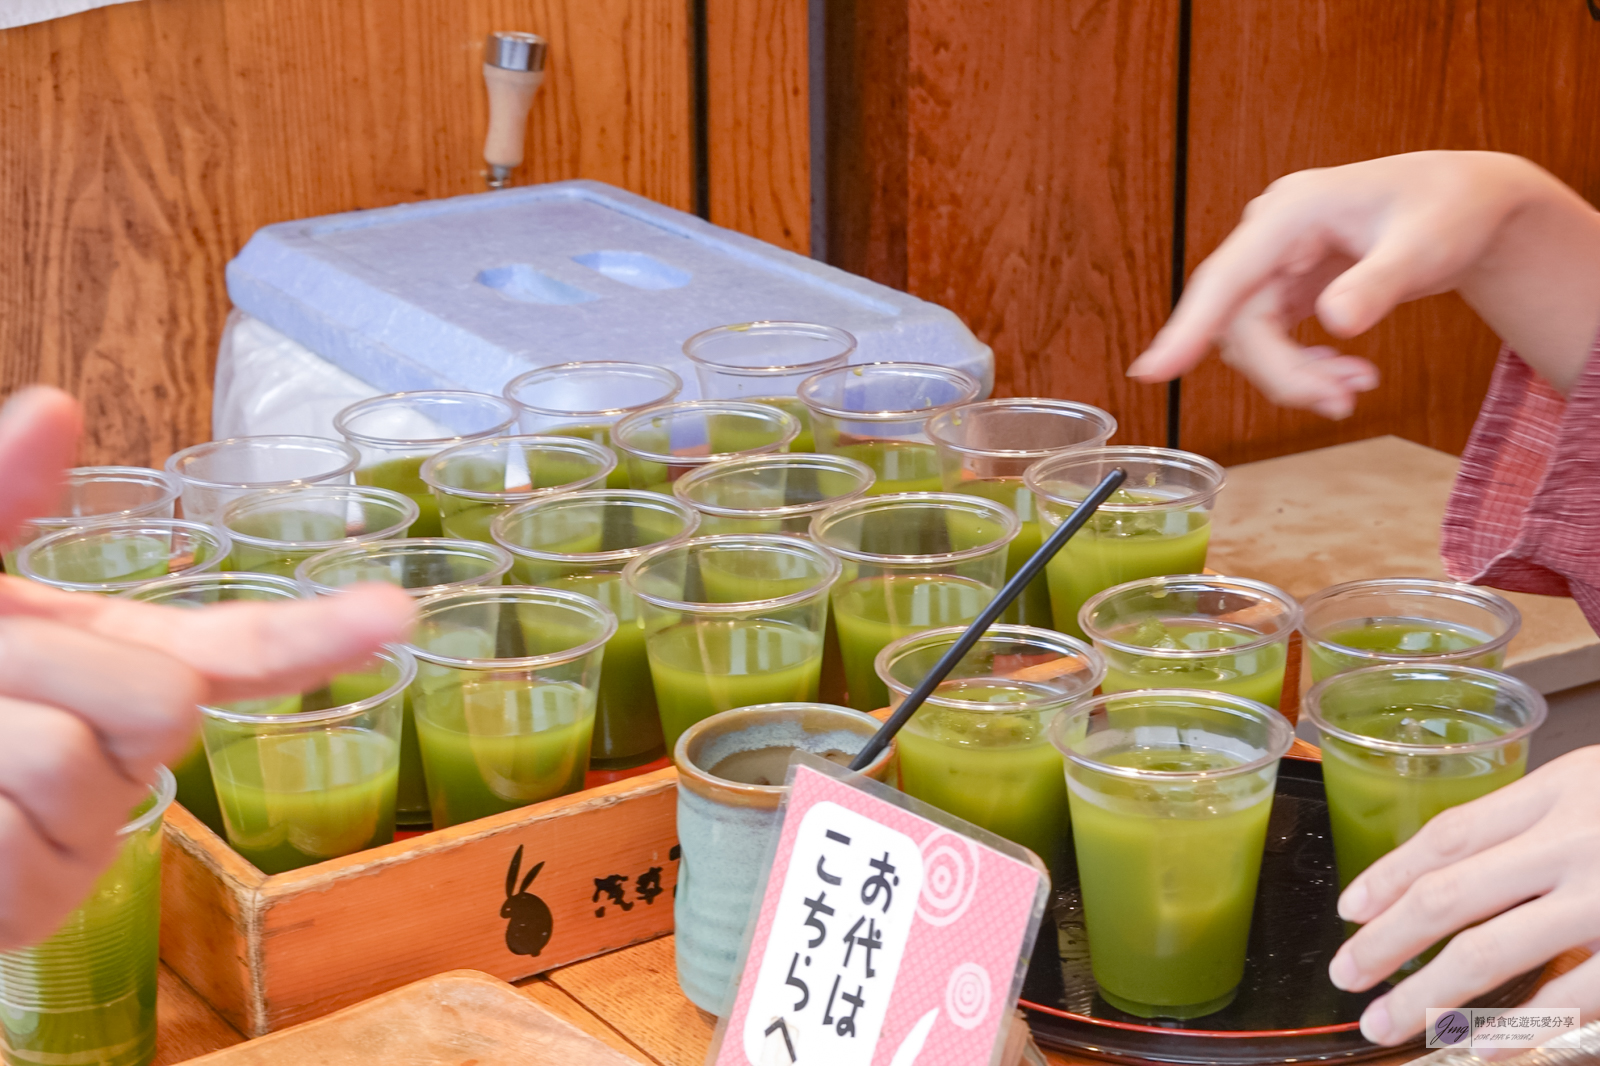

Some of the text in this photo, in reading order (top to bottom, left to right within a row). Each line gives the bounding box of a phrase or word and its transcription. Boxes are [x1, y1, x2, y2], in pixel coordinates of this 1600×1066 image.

[592, 843, 681, 918] 浅草
[764, 829, 851, 1063] こちらへ
[823, 851, 900, 1038] お代は
